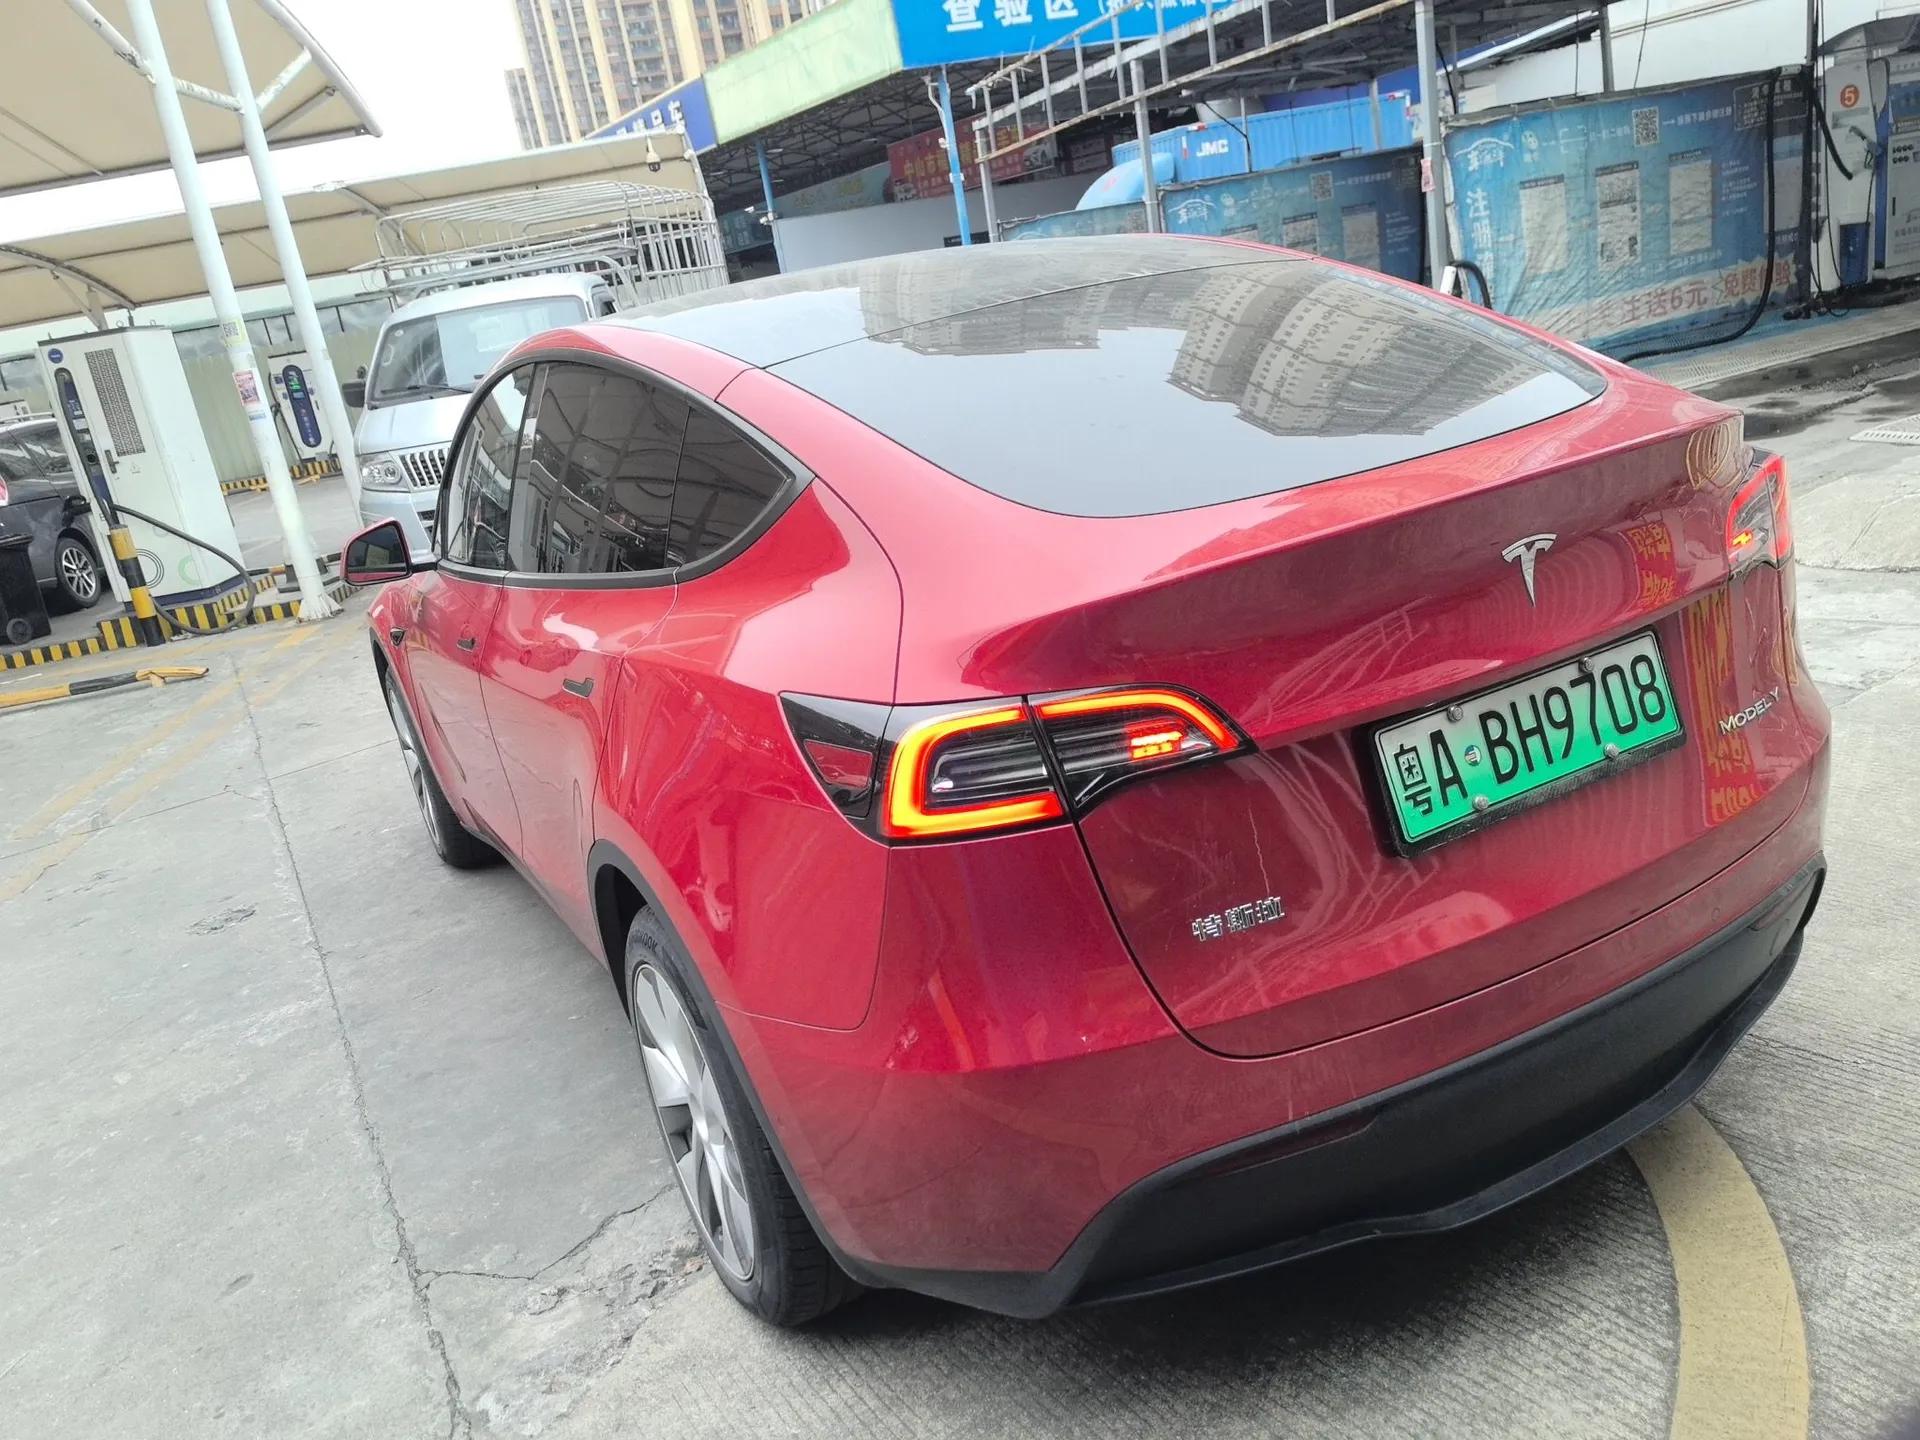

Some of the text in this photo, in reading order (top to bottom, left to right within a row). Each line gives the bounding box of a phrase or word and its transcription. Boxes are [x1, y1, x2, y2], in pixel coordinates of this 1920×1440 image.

[1844, 87, 1856, 105] 5
[1196, 139, 1229, 157] JMC
[1719, 686, 1779, 736] MODEL Y
[1191, 896, 1285, 942] 特斯拉
